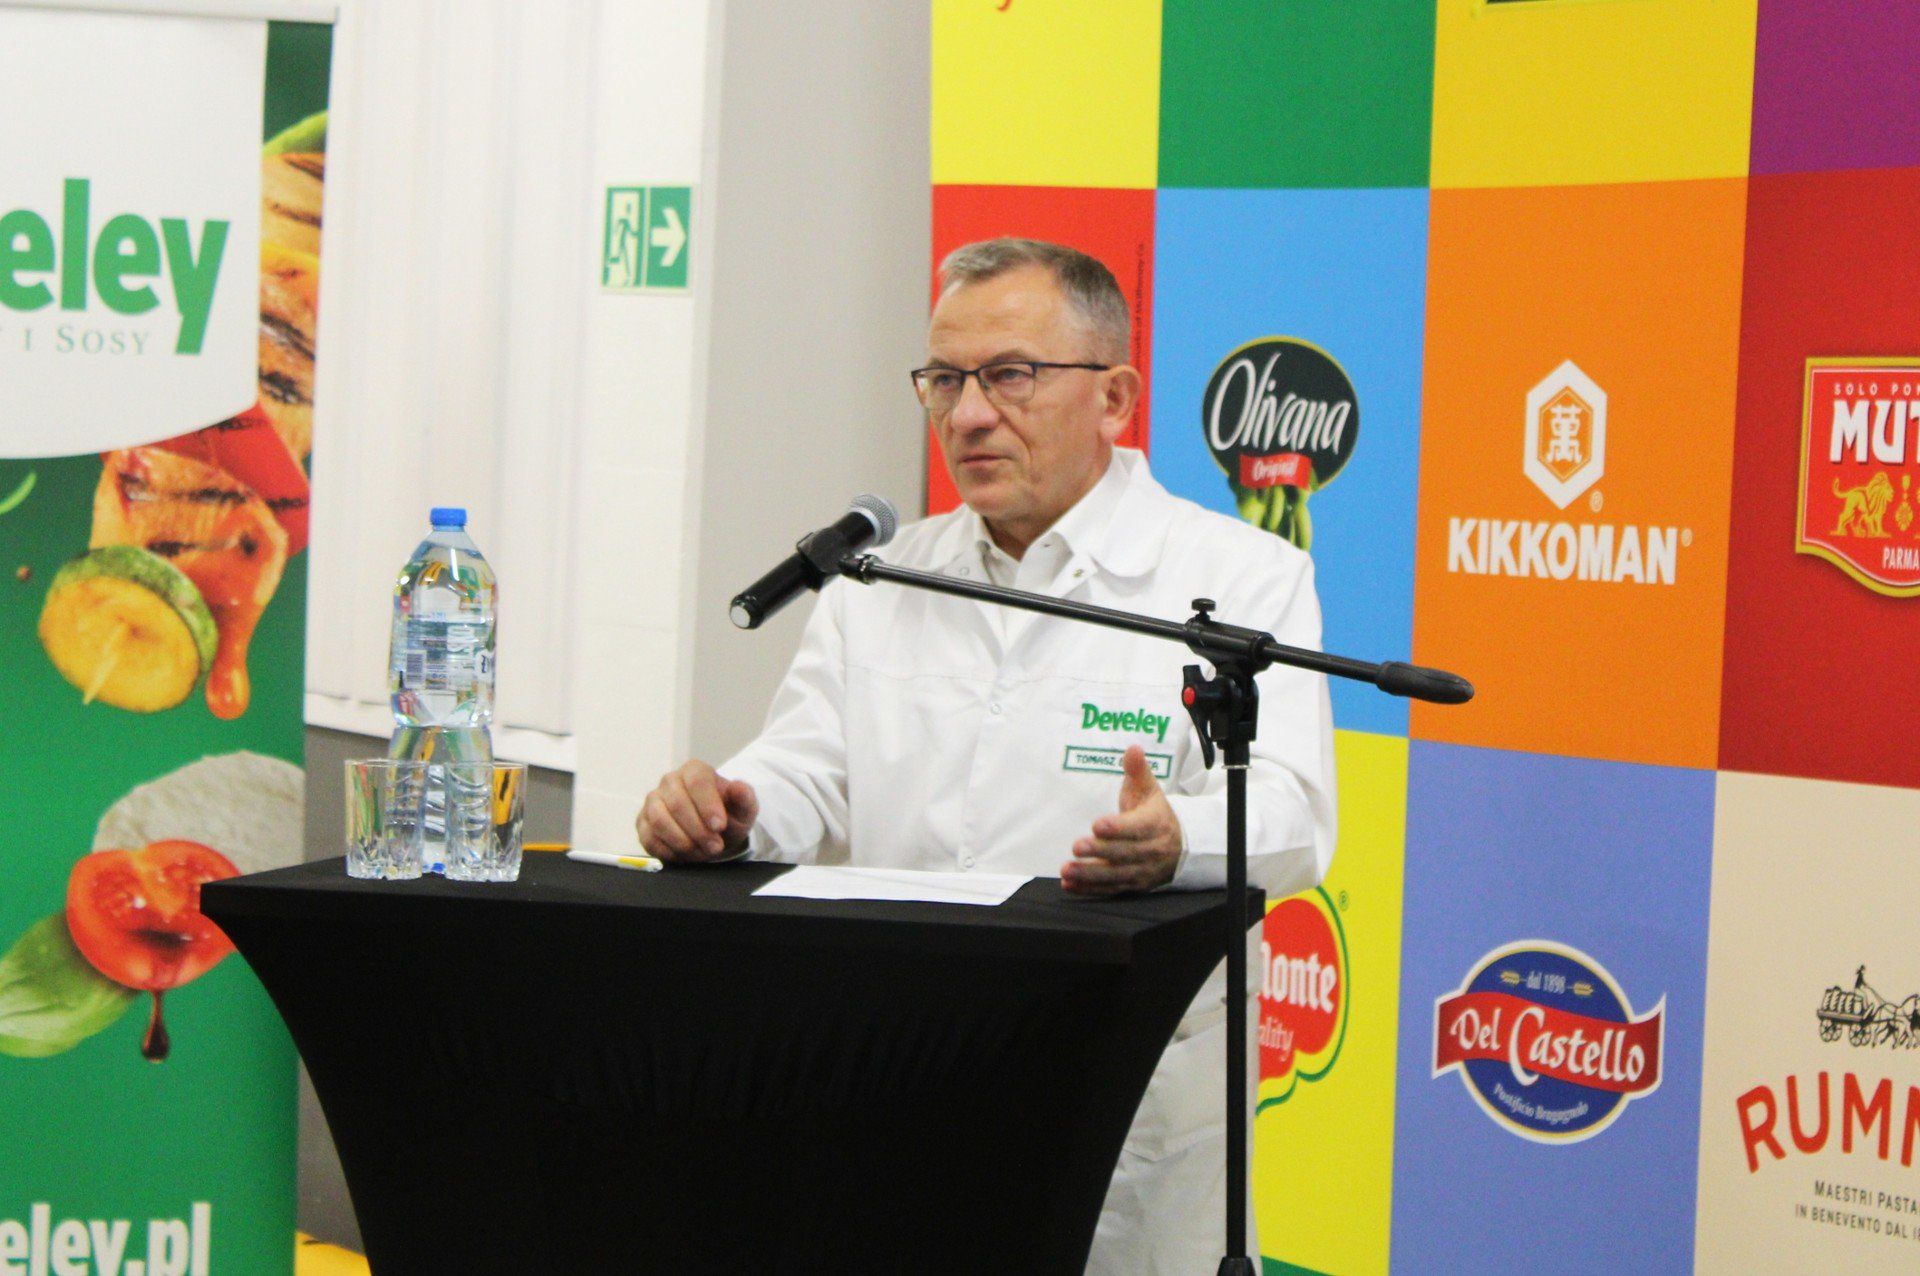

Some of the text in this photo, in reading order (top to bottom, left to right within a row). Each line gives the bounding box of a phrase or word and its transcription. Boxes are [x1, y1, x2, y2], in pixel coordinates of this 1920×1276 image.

[1210, 352, 1352, 455] Olivana
[1834, 383, 1878, 396] SOLO
[1252, 455, 1300, 485] Original
[1447, 516, 1678, 585] KIKKOMAN
[1882, 546, 1920, 570] PARMA
[1081, 703, 1171, 743] Develey
[1076, 754, 1116, 767] TOMASZ
[1450, 1006, 1645, 1086] Del Castello
[1814, 1180, 1873, 1205] MAESTRI
[1795, 1203, 1807, 1218] IN
[1811, 1207, 1881, 1233] BENEVENTO
[1885, 1221, 1908, 1239] DAL
